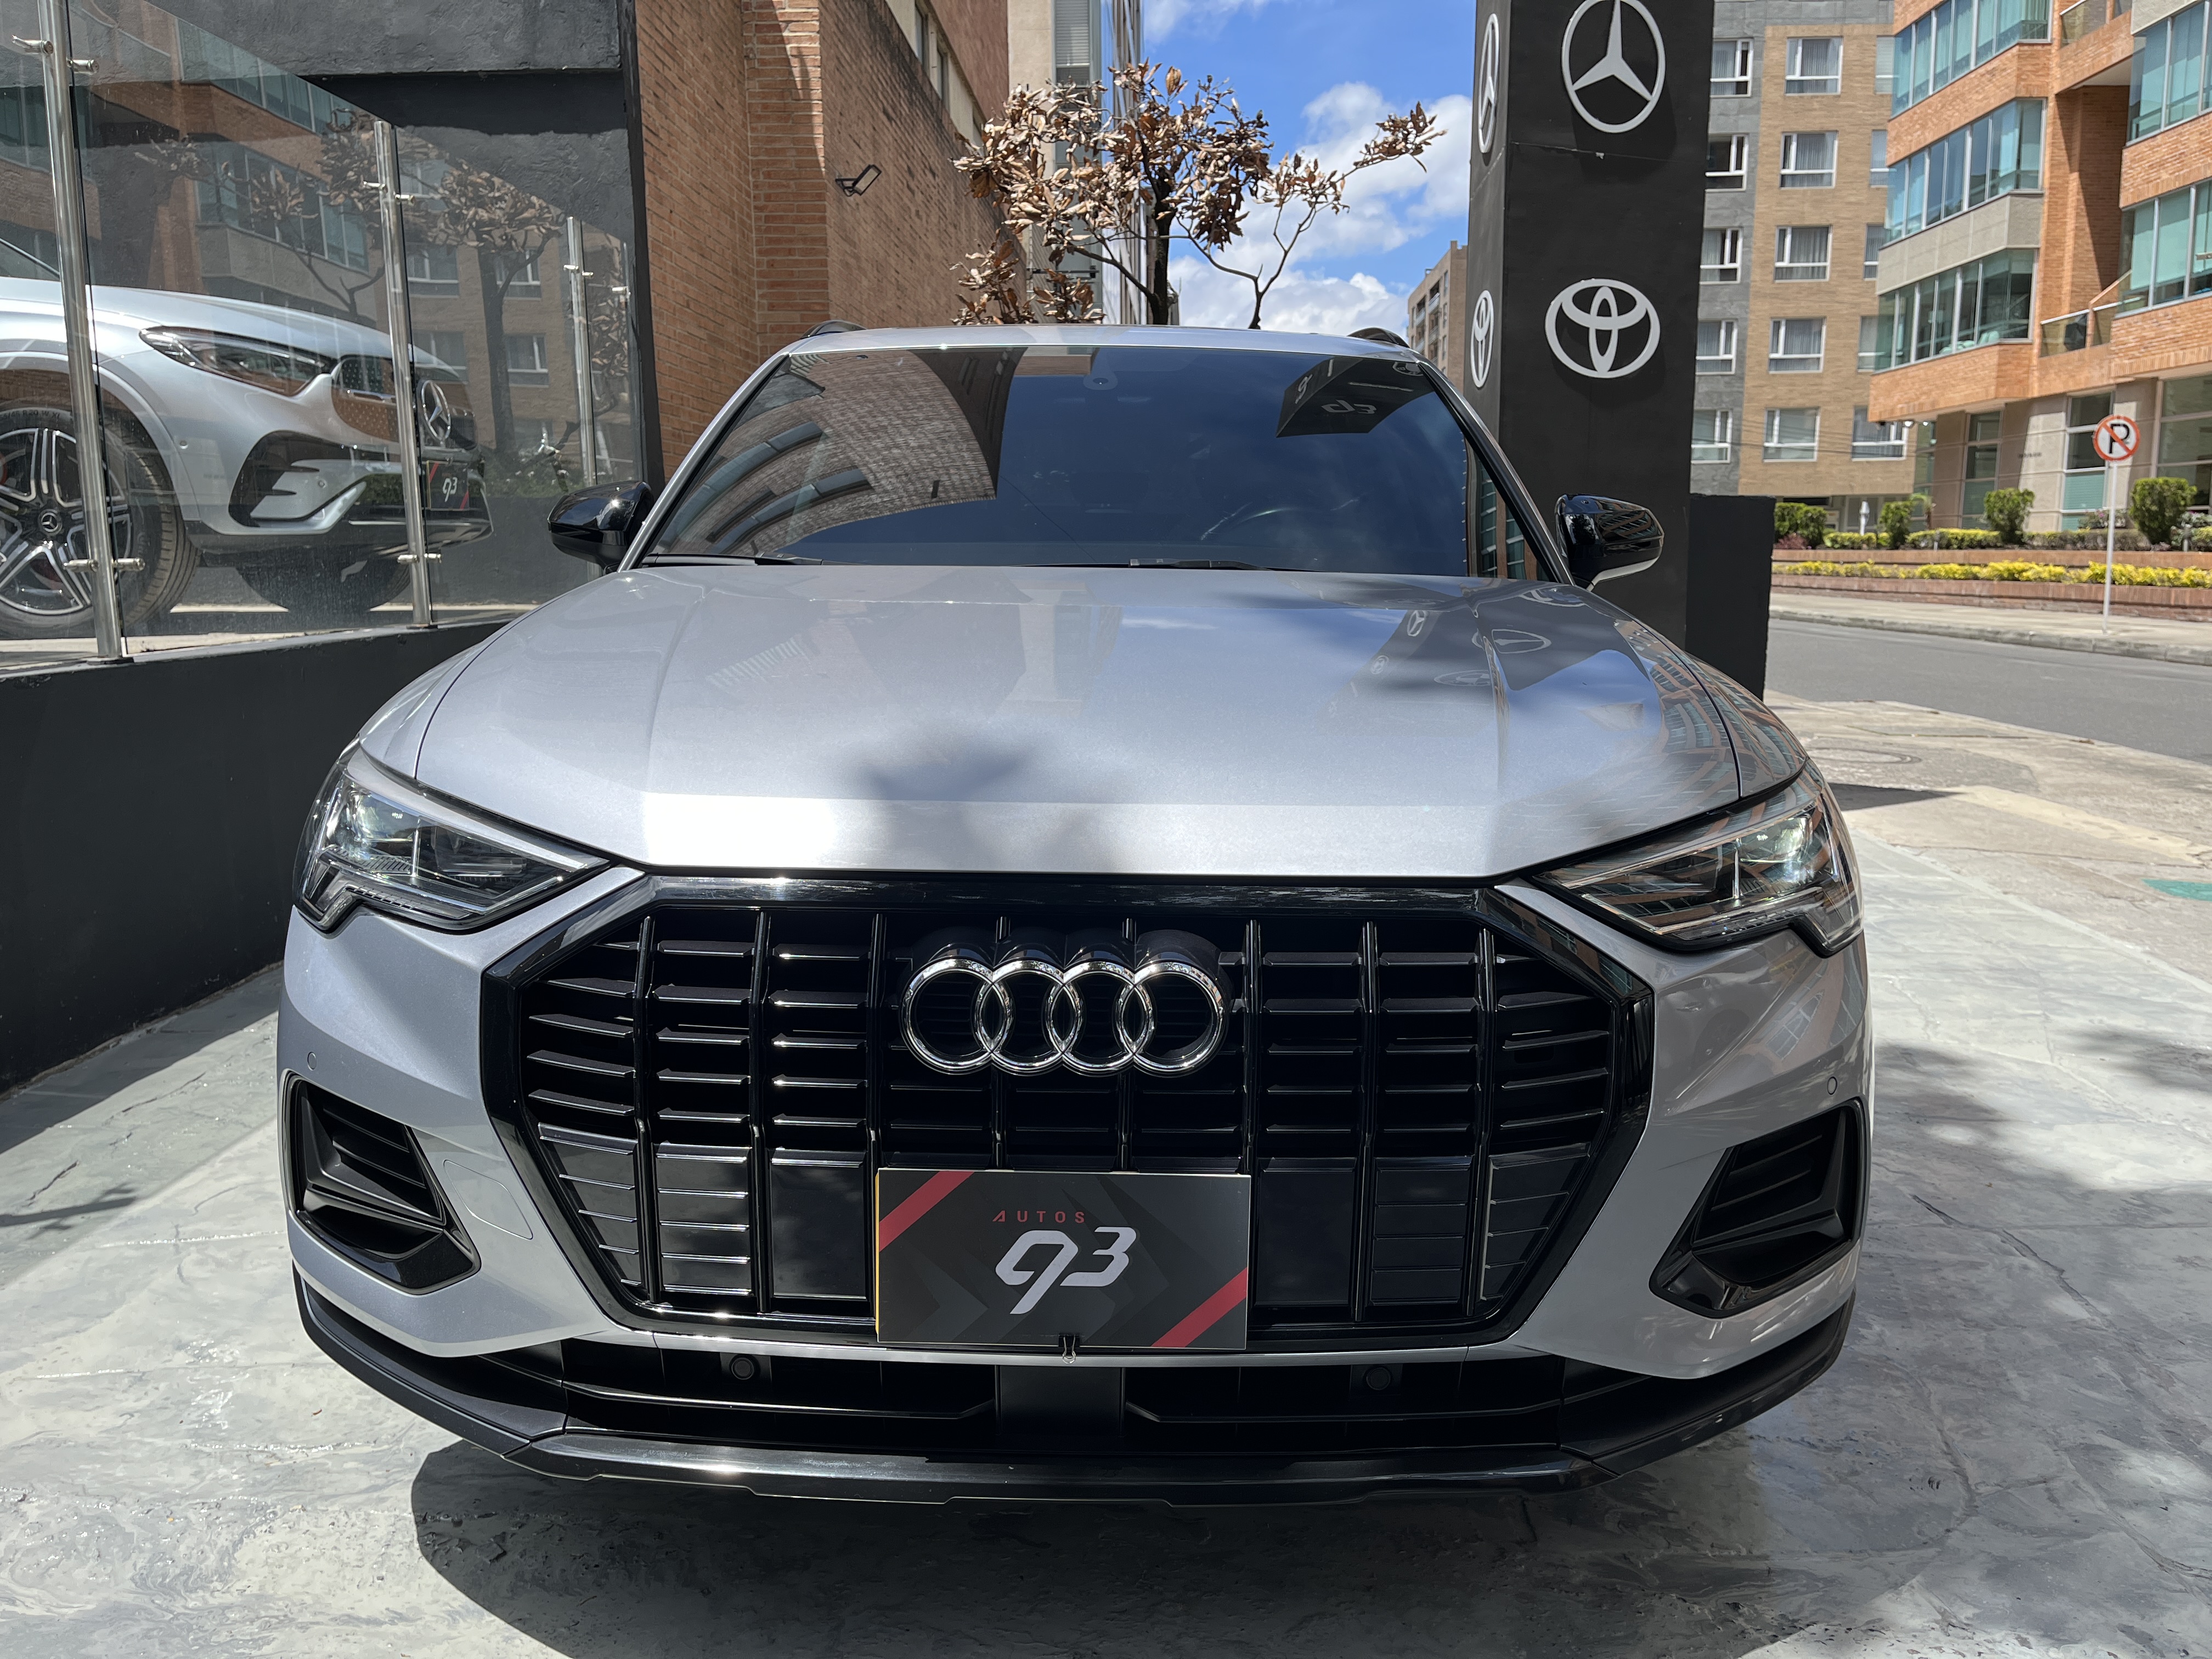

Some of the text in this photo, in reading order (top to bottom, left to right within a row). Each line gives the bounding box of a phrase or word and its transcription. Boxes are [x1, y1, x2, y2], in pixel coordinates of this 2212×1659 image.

[2109, 424, 2130, 454] P
[442, 476, 458, 503] 93
[992, 1210, 1085, 1223] AUTOS
[995, 1226, 1137, 1314] 93
